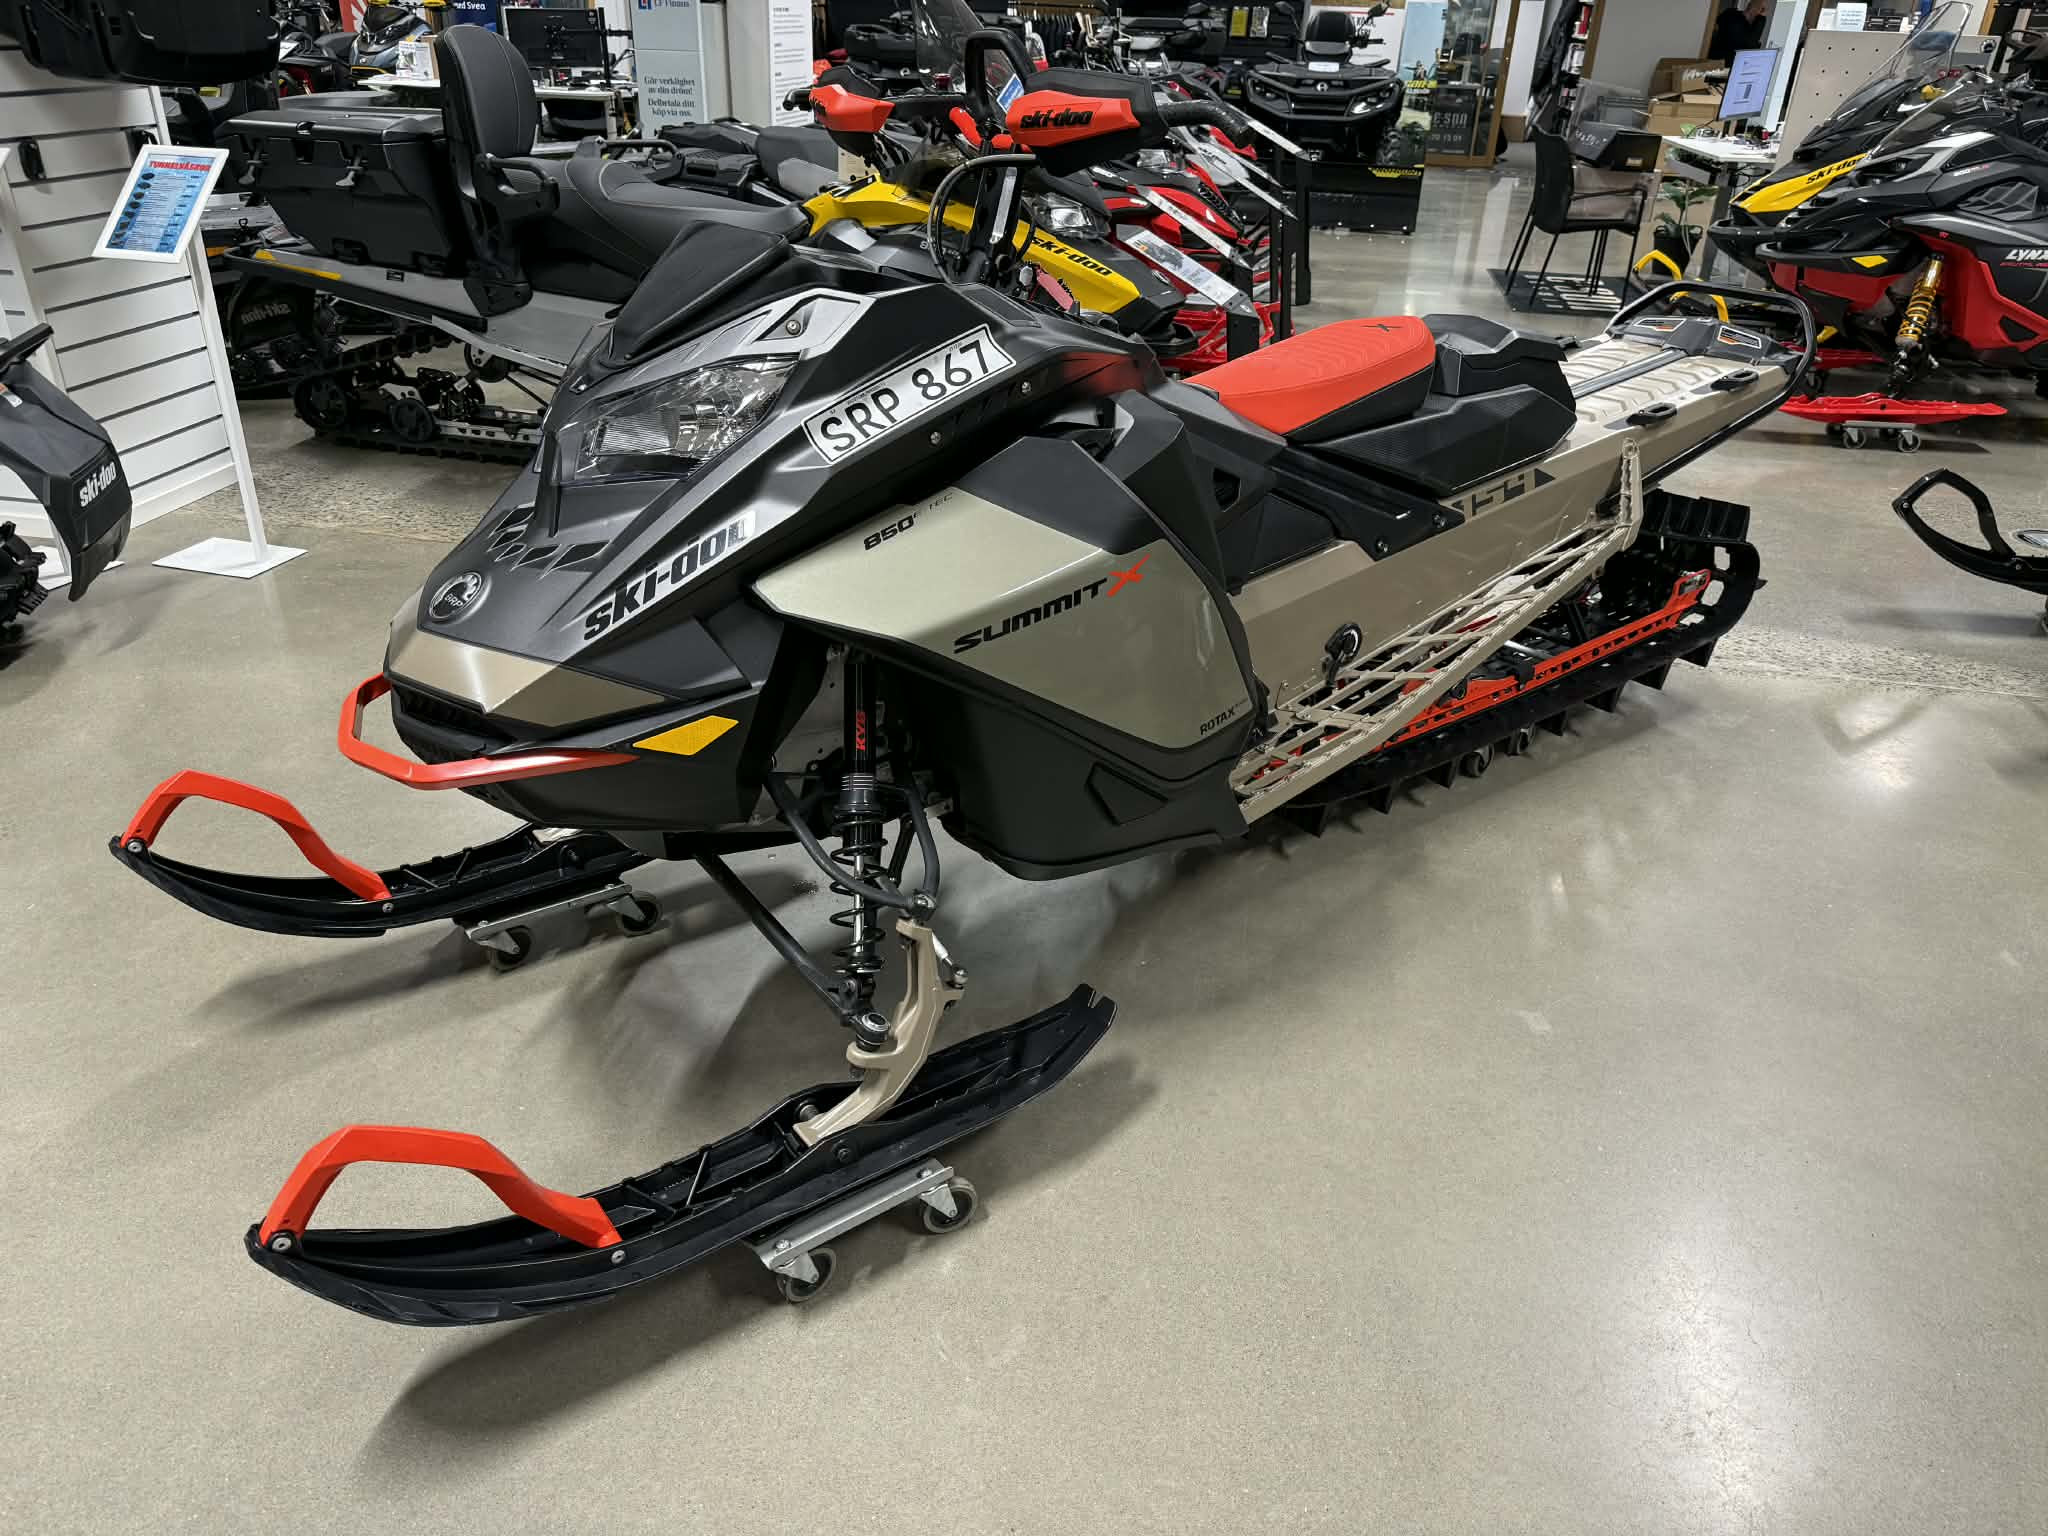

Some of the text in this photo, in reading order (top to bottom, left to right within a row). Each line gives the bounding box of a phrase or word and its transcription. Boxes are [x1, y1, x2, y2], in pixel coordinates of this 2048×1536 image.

[1020, 107, 1094, 128] ski-doo
[819, 339, 989, 452] SRP 867
[80, 461, 117, 508] ski-doo
[863, 514, 914, 551] 850
[584, 511, 757, 641] ski-doo
[445, 593, 464, 607] BRP
[954, 577, 1108, 654] SUMMIT
[1200, 705, 1235, 736] ROTAX
